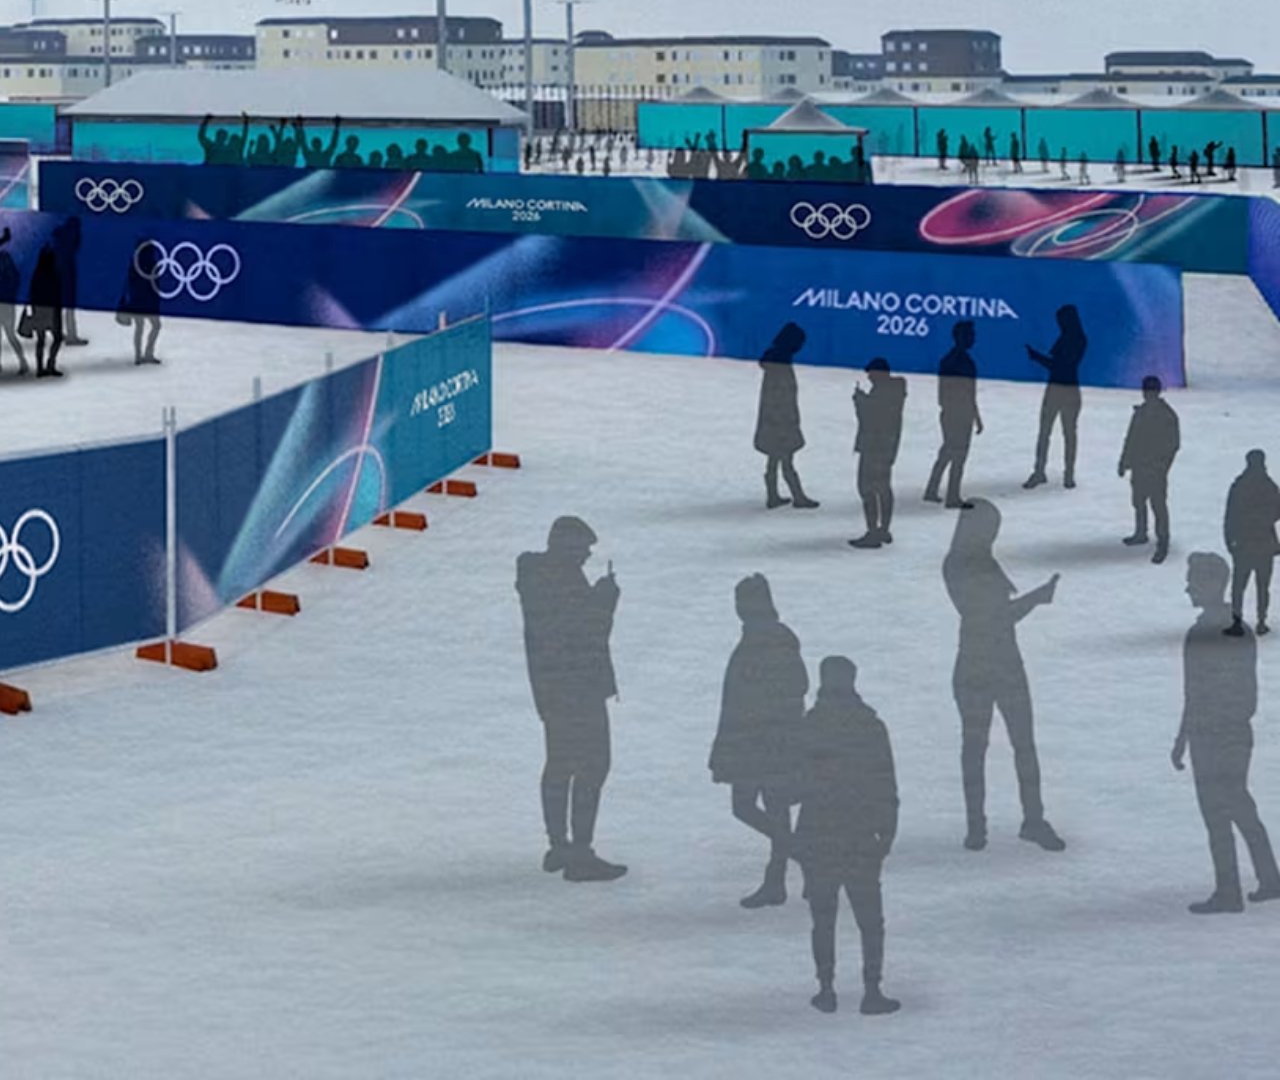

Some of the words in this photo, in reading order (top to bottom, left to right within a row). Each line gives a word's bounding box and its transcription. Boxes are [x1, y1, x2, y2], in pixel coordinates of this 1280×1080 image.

[465, 197, 525, 210] MILANO
[526, 199, 588, 212] CORTINA
[793, 288, 900, 311] MILANO
[904, 293, 1019, 319] CORTINA
[877, 314, 929, 337] 2026
